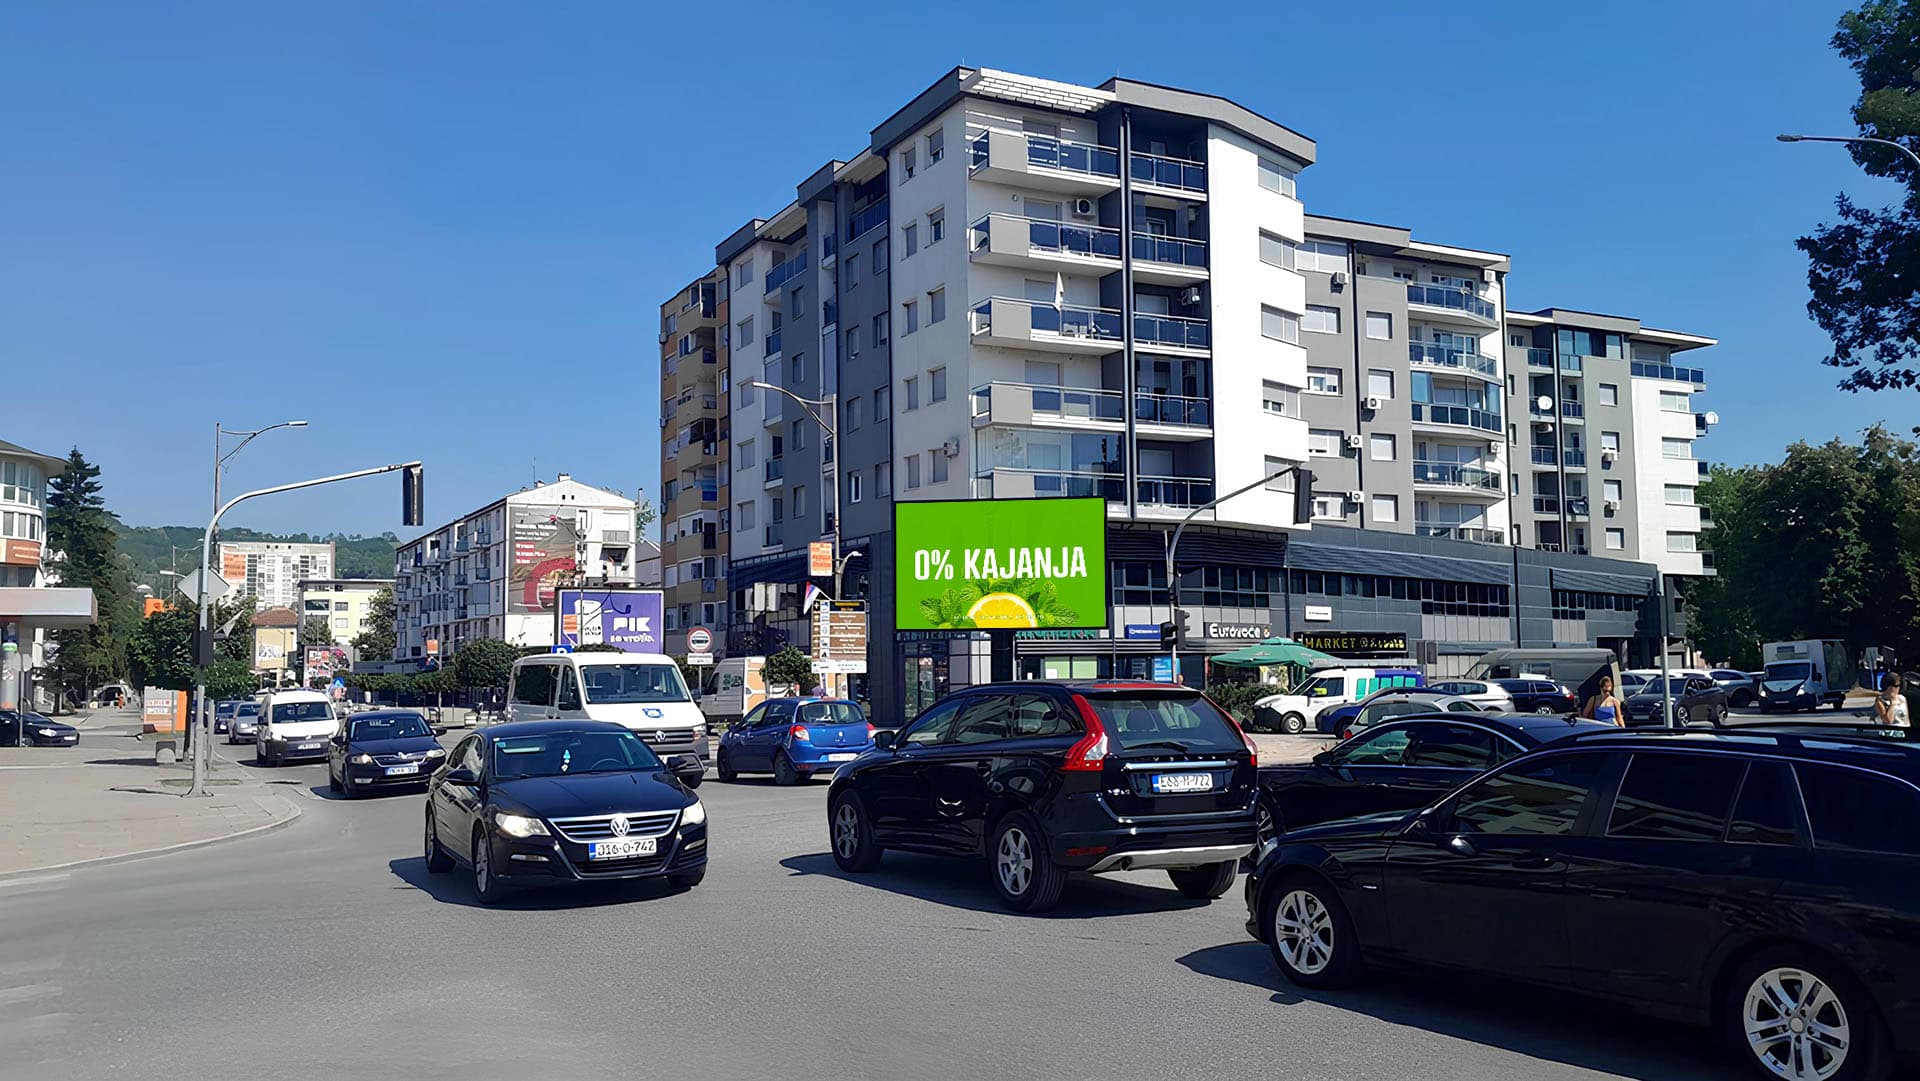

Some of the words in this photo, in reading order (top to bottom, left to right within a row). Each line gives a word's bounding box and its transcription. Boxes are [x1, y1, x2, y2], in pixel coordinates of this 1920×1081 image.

[914, 549, 954, 580] 0%
[964, 546, 1087, 580] KAJANJA
[1305, 637, 1356, 649] MARKET
